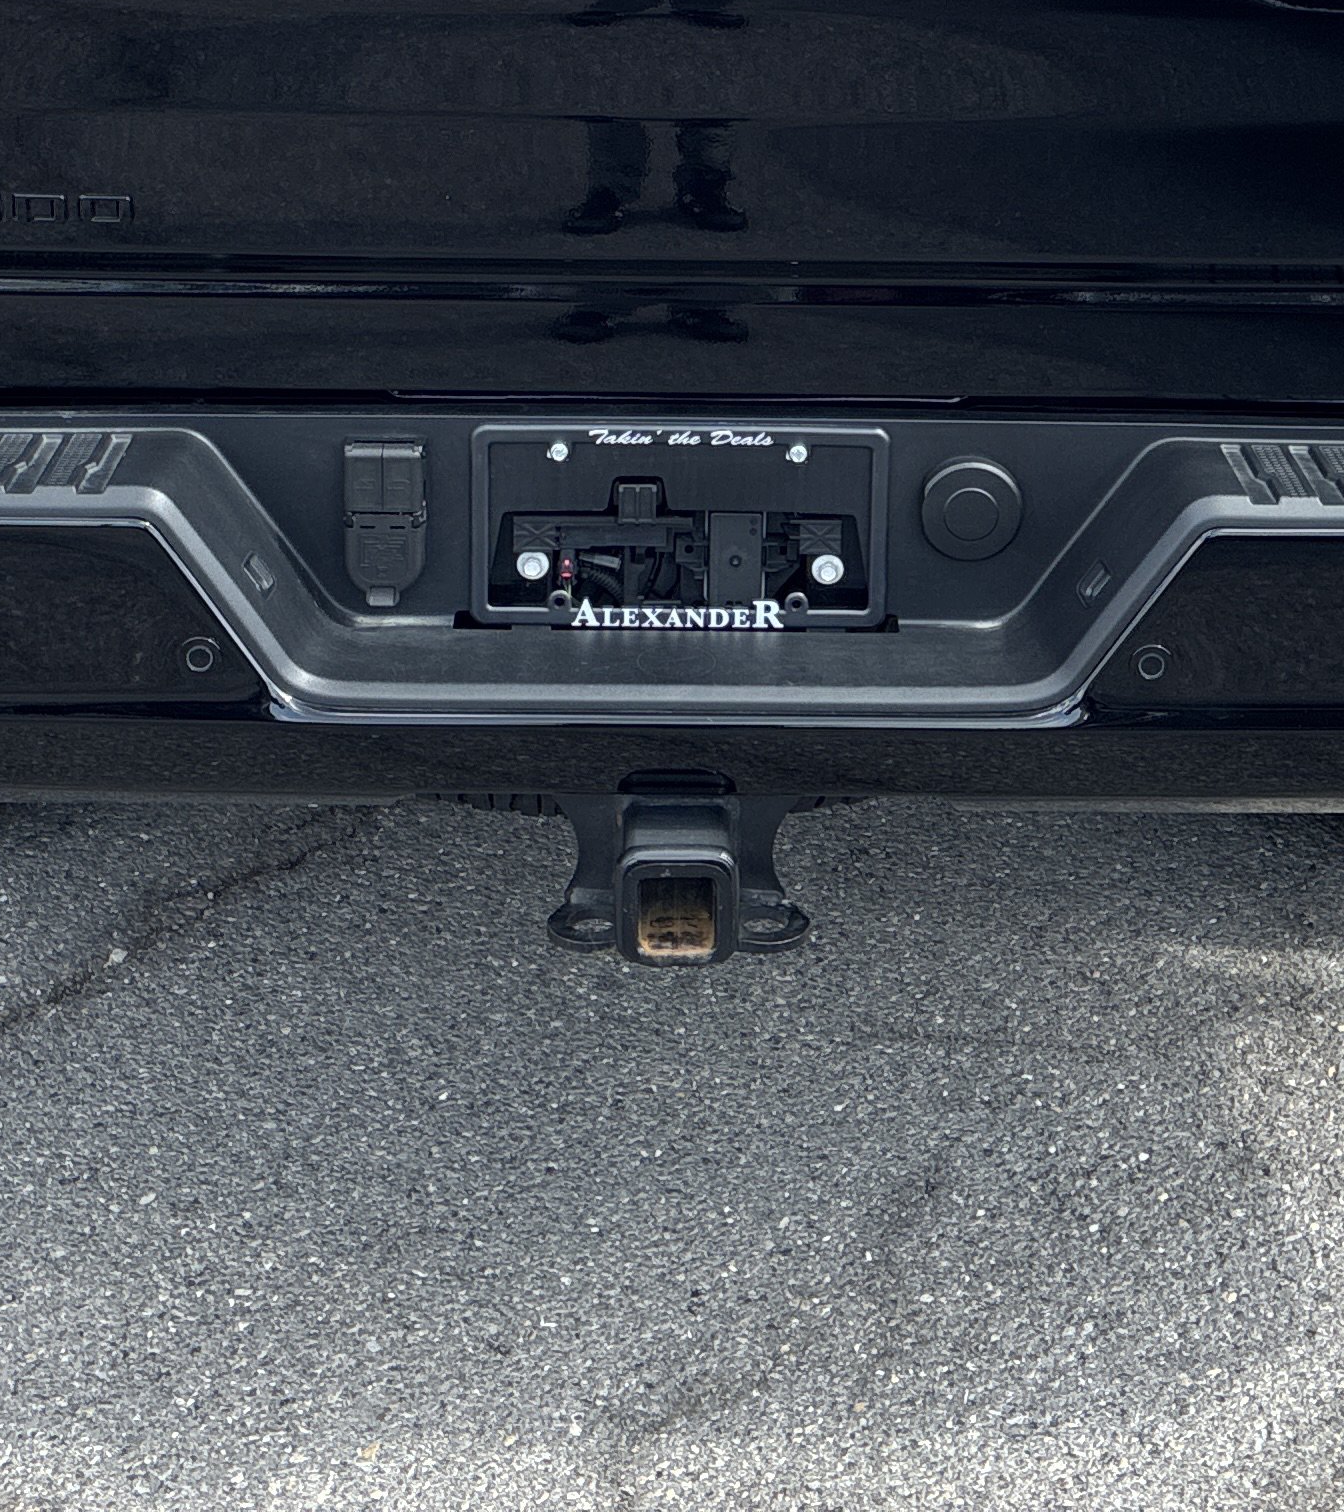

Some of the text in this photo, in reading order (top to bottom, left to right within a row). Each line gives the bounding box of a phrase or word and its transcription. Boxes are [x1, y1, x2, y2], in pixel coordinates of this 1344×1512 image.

[588, 429, 774, 446] Takin' the Deals
[571, 597, 784, 629] ALEXANDER
